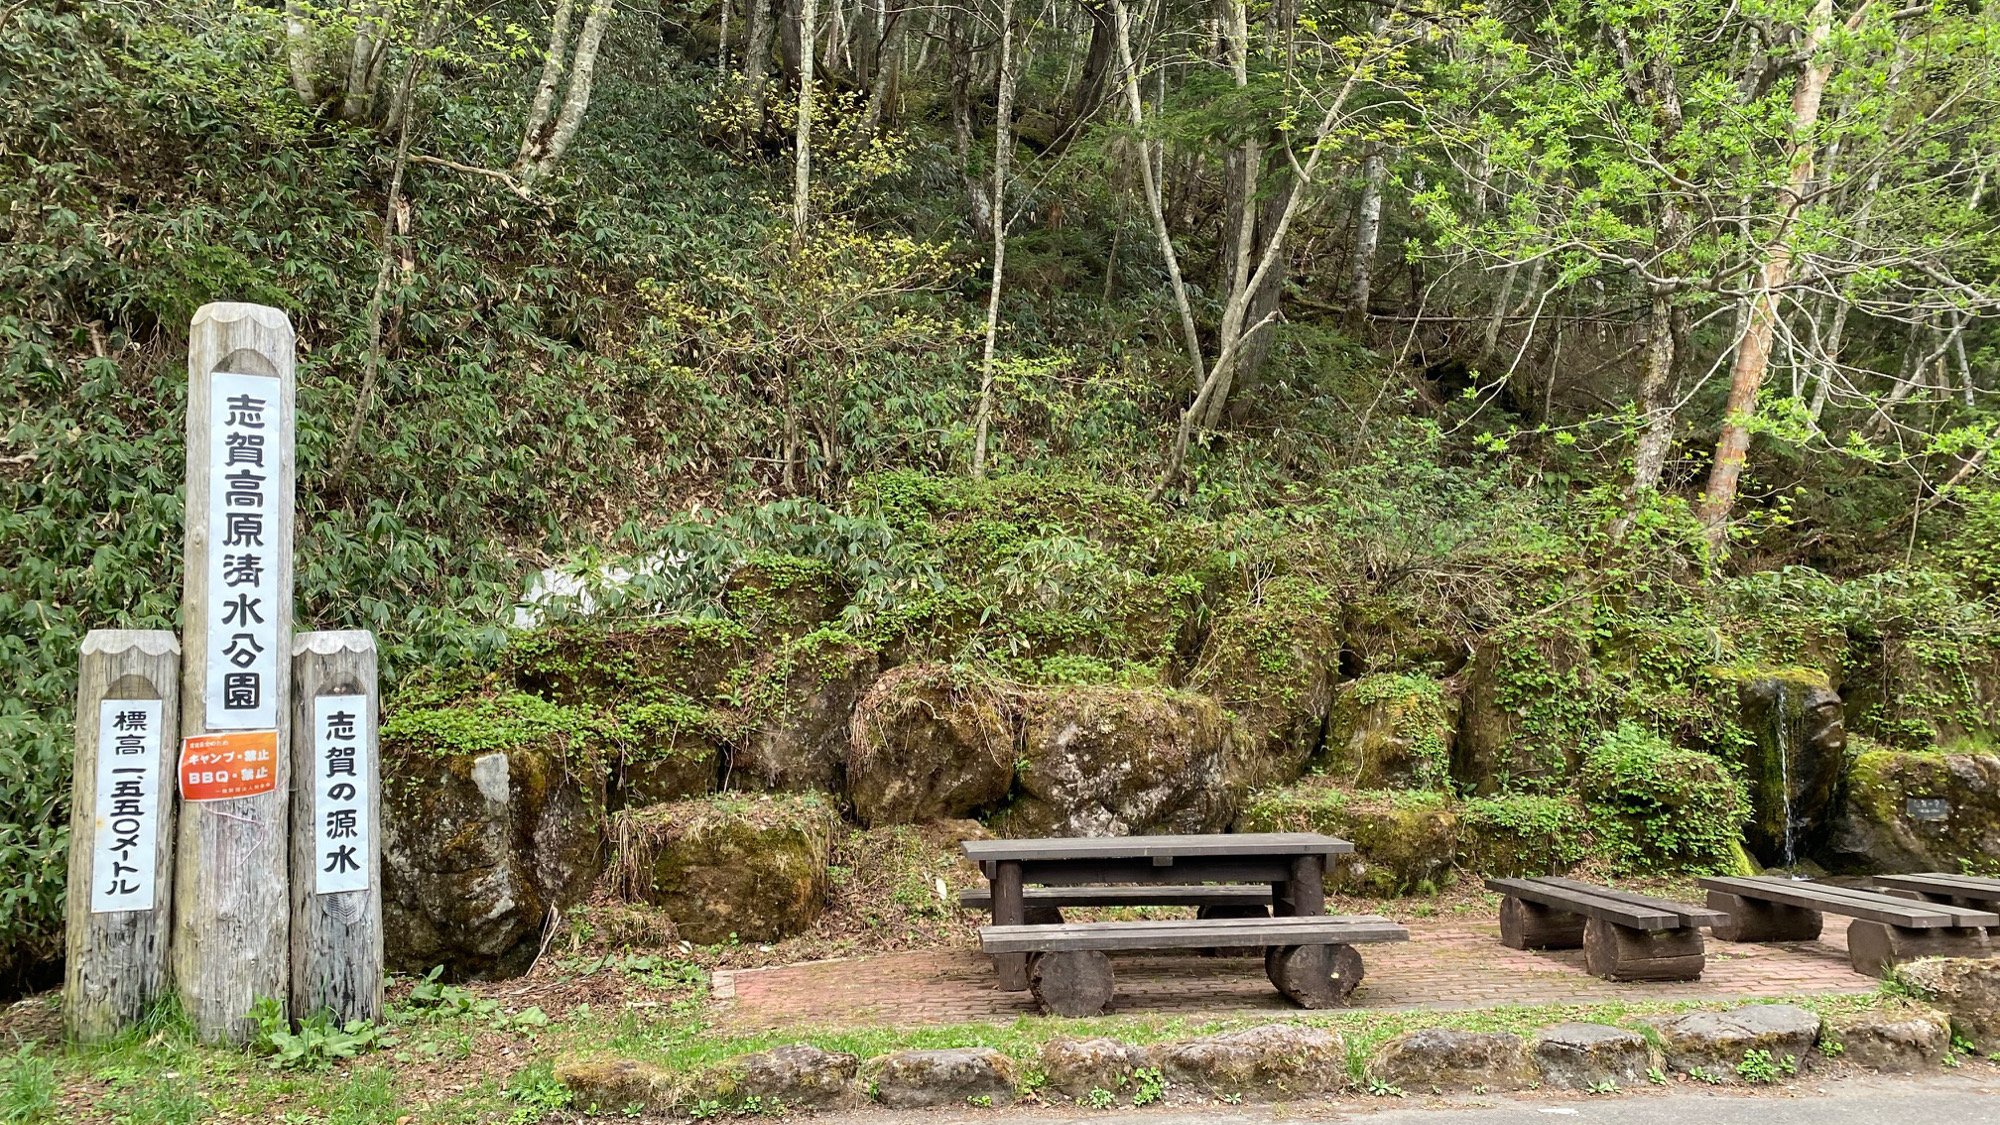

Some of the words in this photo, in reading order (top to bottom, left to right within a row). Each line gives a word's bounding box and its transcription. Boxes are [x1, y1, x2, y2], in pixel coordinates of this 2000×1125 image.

[221, 393, 267, 710] 志賀高原清水公園
[324, 710, 361, 874] 志賀の源水
